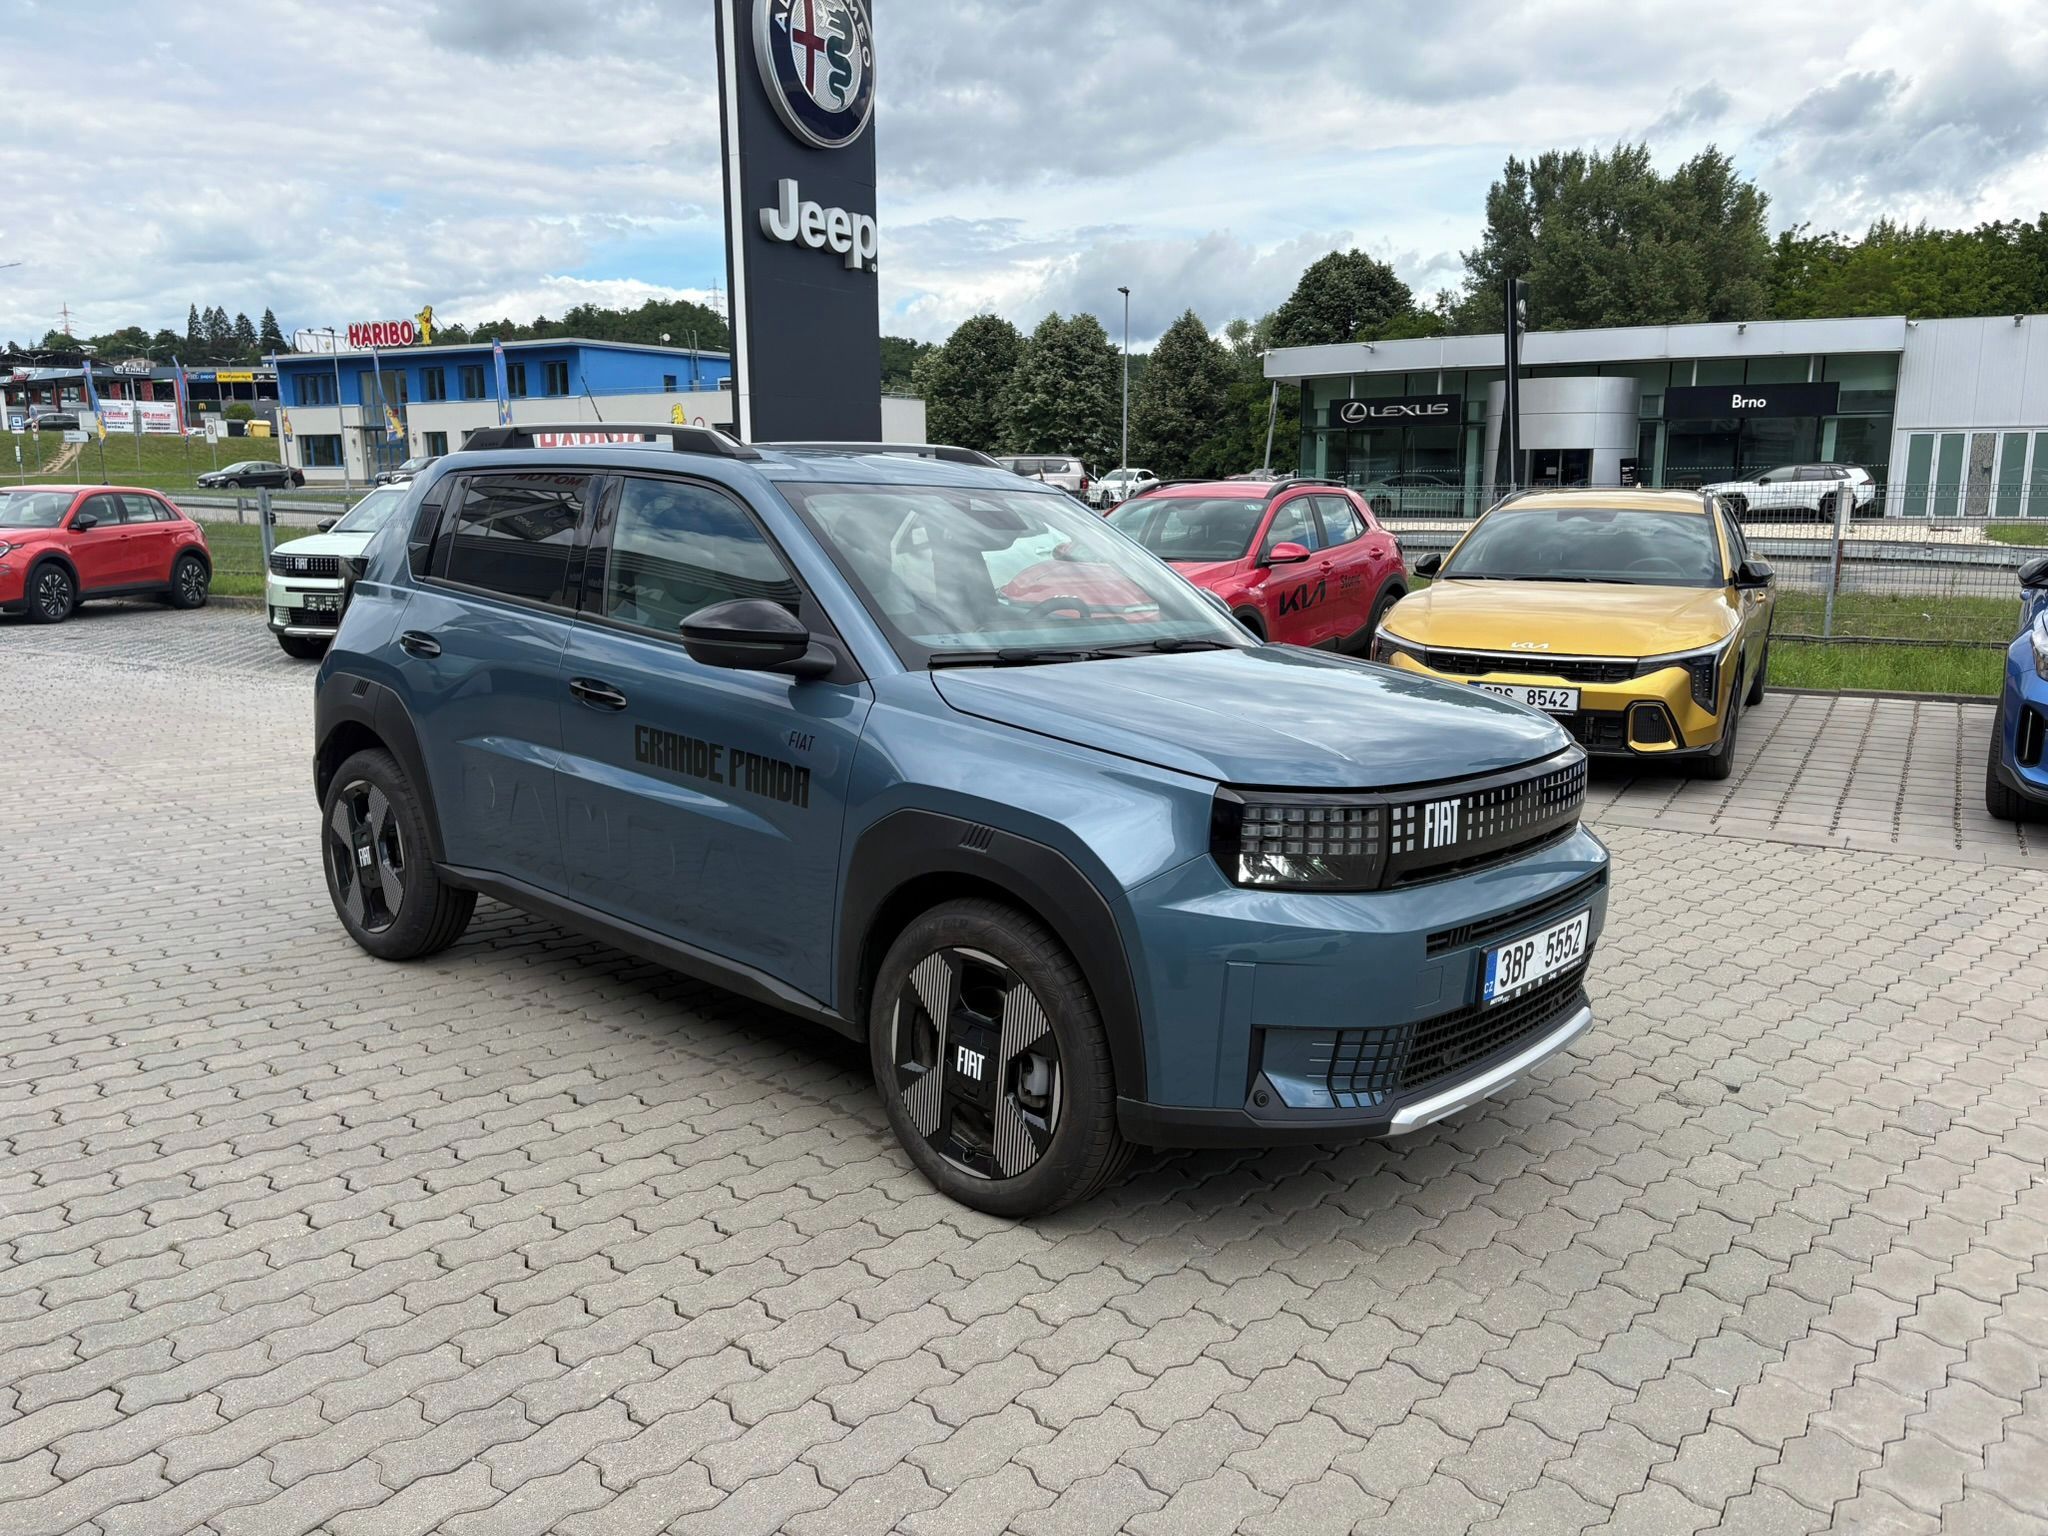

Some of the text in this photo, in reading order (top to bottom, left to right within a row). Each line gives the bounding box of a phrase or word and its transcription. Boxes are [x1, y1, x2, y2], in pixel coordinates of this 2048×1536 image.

[759, 178, 877, 269] Jeep
[348, 320, 413, 347] HARIBO
[1369, 403, 1449, 417] LEXUS
[1731, 394, 1767, 408] Brno
[1279, 578, 1327, 616] KIA
[1526, 689, 1570, 708] 8542
[788, 731, 815, 752] FIAT
[635, 724, 811, 809] GRANDE PANDA
[1423, 799, 1461, 849] FIAT
[1500, 920, 1582, 987] 3BP 5552
[1484, 981, 1494, 993] CZ
[957, 1045, 985, 1080] FIAT
